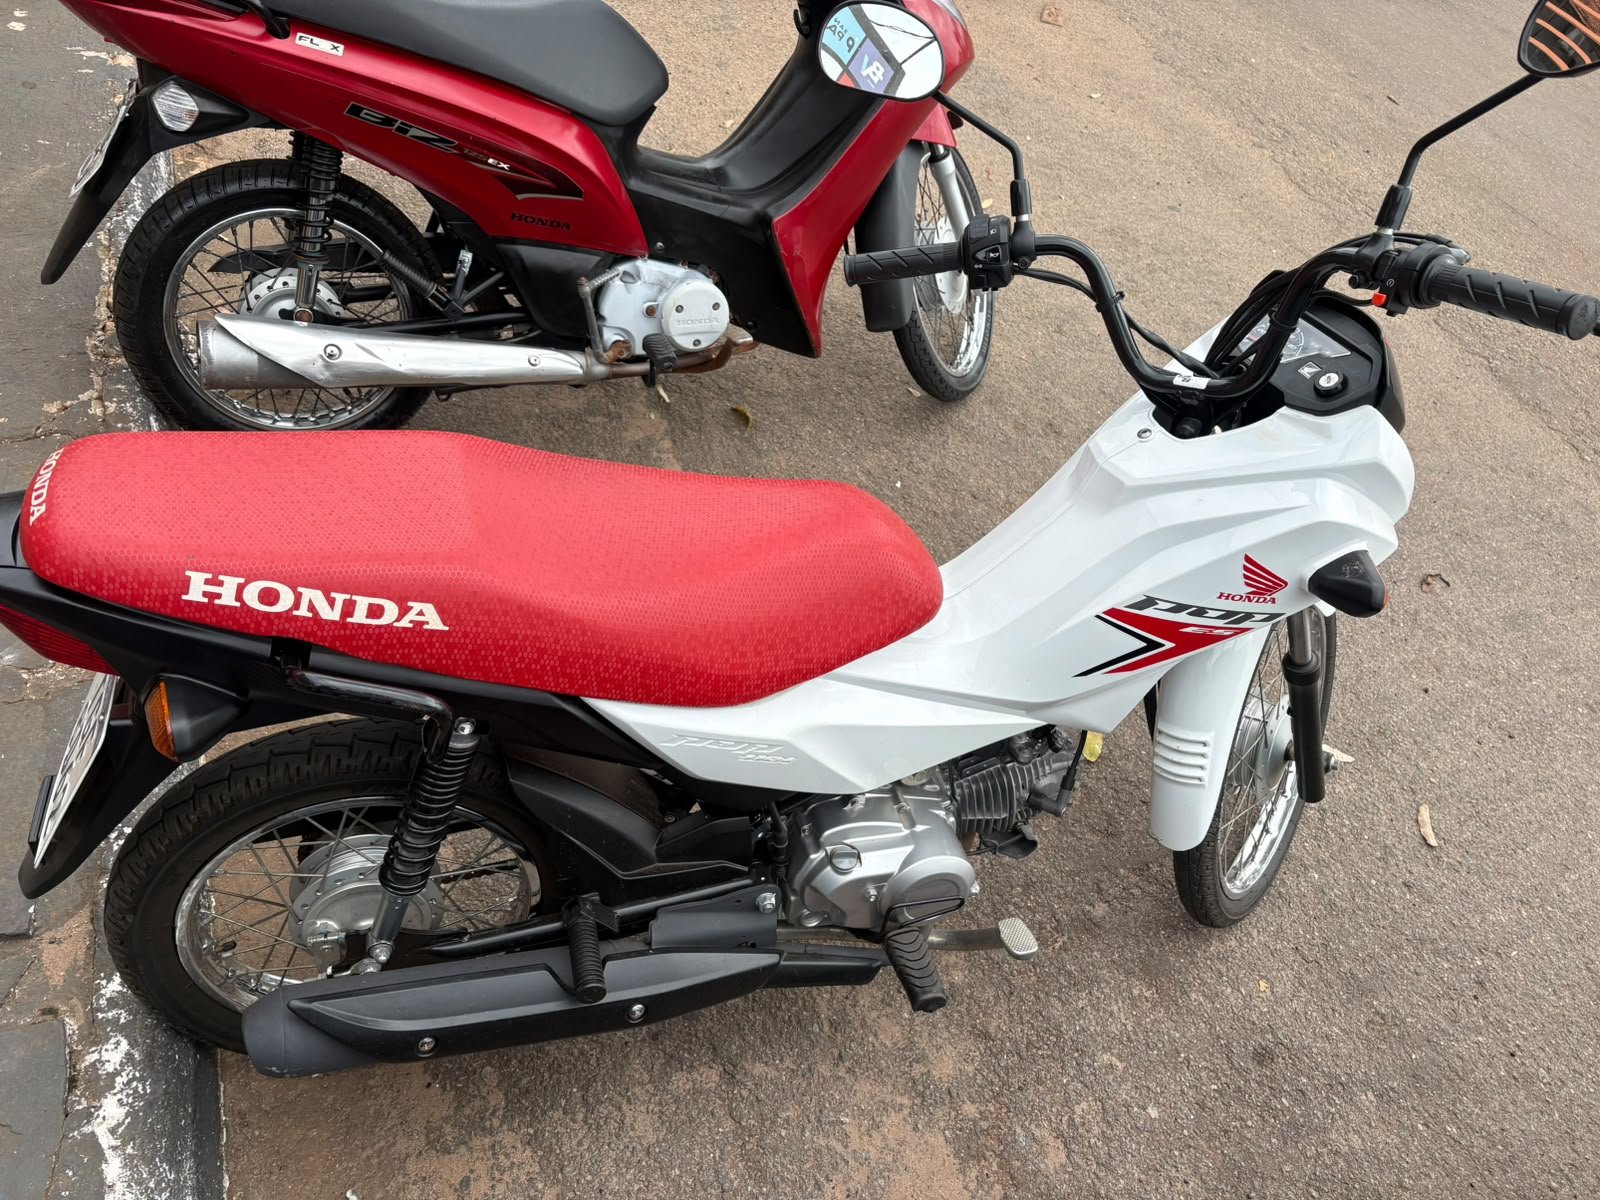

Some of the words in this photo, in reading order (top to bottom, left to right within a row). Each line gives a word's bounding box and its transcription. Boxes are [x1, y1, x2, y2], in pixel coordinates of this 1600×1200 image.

[487, 157, 511, 171] EX
[511, 211, 572, 230] HONDA
[675, 316, 719, 327] HONDA
[29, 448, 64, 527] HONDA
[181, 570, 449, 631] HONDA
[1216, 592, 1276, 605] HONDA
